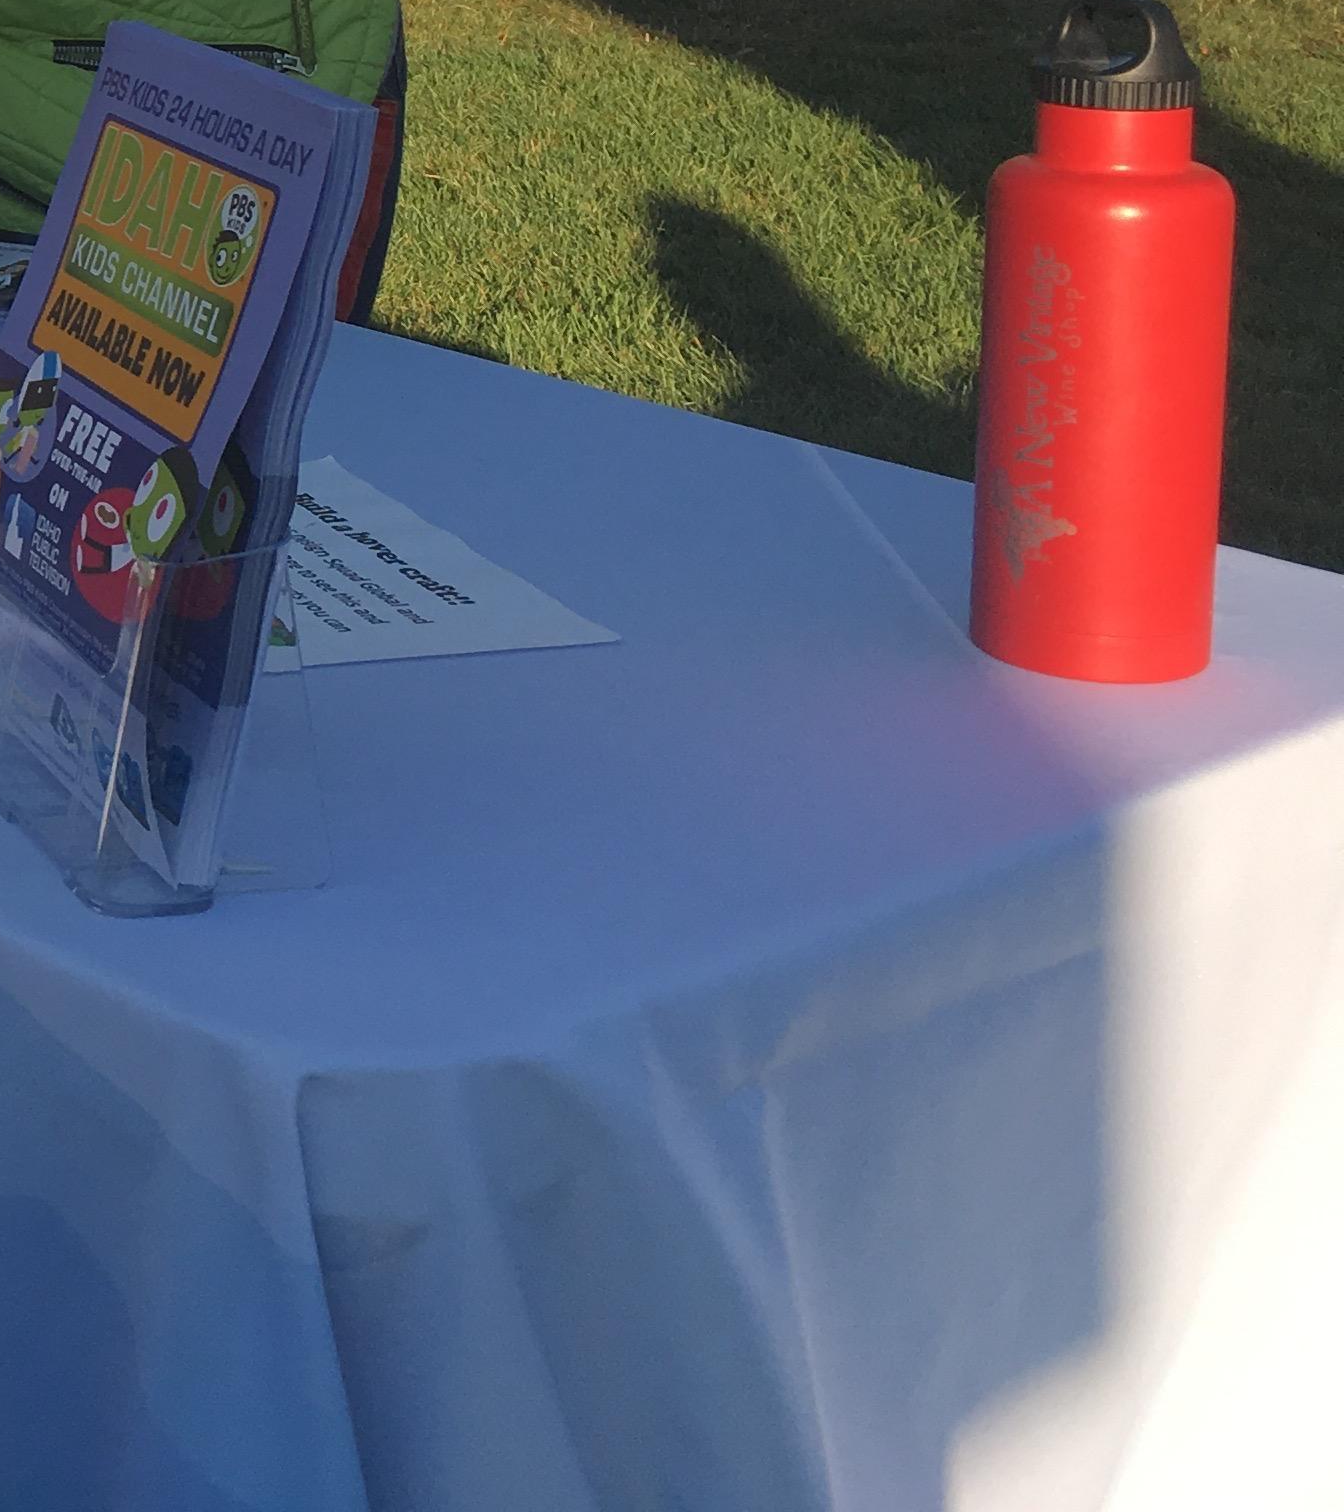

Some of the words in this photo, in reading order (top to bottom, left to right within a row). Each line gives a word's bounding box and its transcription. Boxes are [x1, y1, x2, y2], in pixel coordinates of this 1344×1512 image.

[100, 66, 131, 102] PBS
[127, 79, 169, 118] KIDS
[165, 95, 194, 128] 24
[190, 103, 254, 153] HOURS
[249, 128, 268, 161] A
[268, 135, 314, 177] DAY
[226, 217, 246, 235] KIDS
[228, 193, 256, 223] PBS
[71, 233, 120, 284] KIDS
[120, 261, 220, 344] CHANNEL
[1016, 244, 1072, 366] Vintage
[1058, 287, 1085, 349] Shop
[46, 289, 153, 378] AVAILABLE
[146, 347, 206, 408] NOW
[1014, 374, 1054, 467] New
[1054, 365, 1078, 426] Wine
[57, 404, 122, 474] FREE
[48, 483, 70, 512] ON
[30, 533, 62, 565] PUBLIC
[36, 513, 62, 544] IDAHO
[28, 549, 72, 596] TELEVISION
[331, 524, 353, 532] a
[343, 531, 409, 566] hover
[398, 567, 476, 606] craft!!
[295, 600, 330, 618] you
[323, 618, 352, 633] can
[353, 608, 391, 625] and
[397, 608, 435, 625] and
